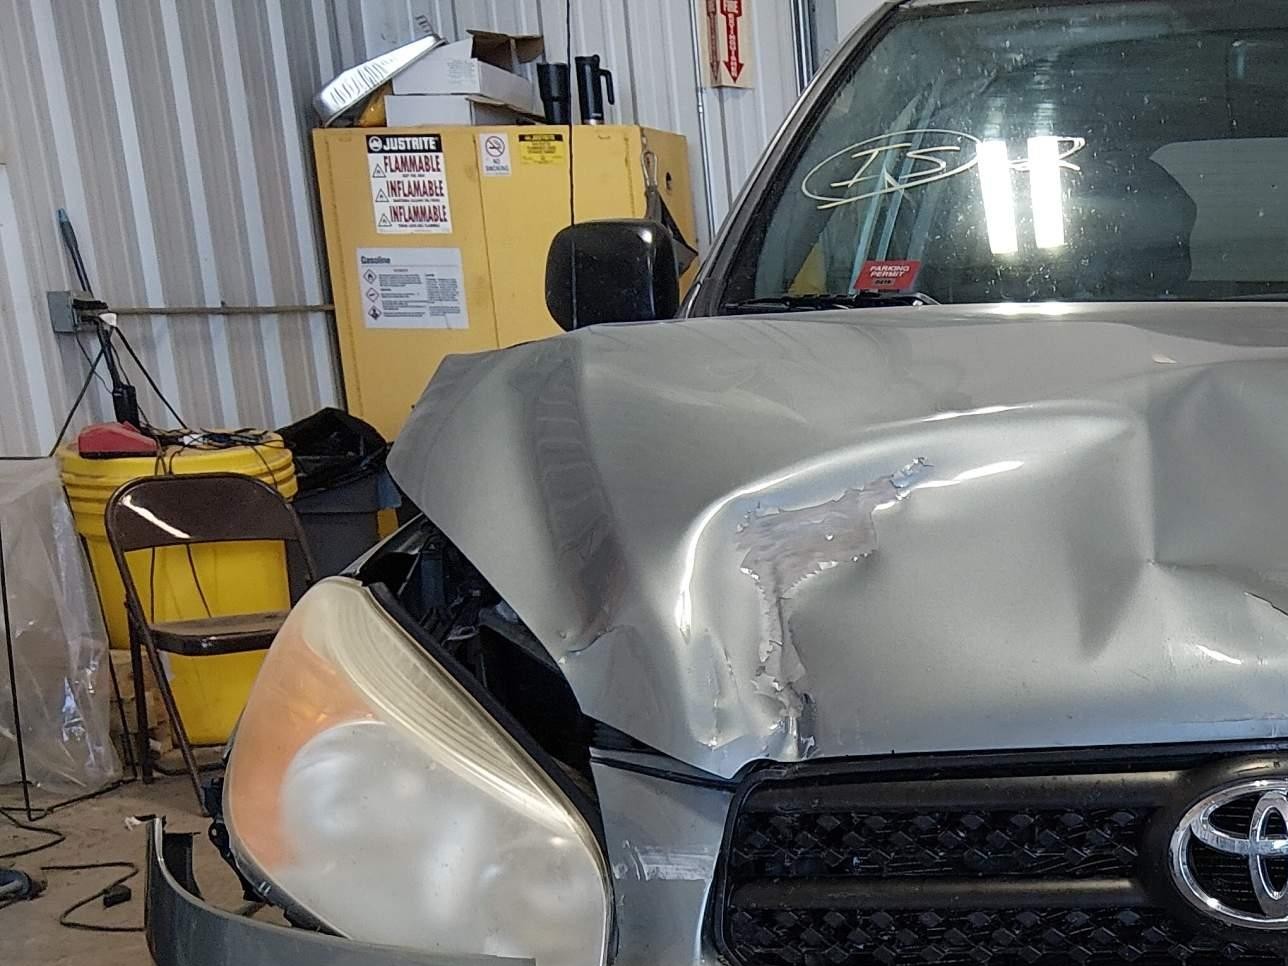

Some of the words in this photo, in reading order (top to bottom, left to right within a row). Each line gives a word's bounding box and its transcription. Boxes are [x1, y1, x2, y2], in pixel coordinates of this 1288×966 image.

[383, 136, 437, 151] JUSTRITE
[383, 155, 441, 173] FLAMMABLE
[386, 180, 445, 198] INFLAMABLE
[389, 205, 448, 223] INFLAMMABLE
[360, 256, 391, 264] Gasoline
